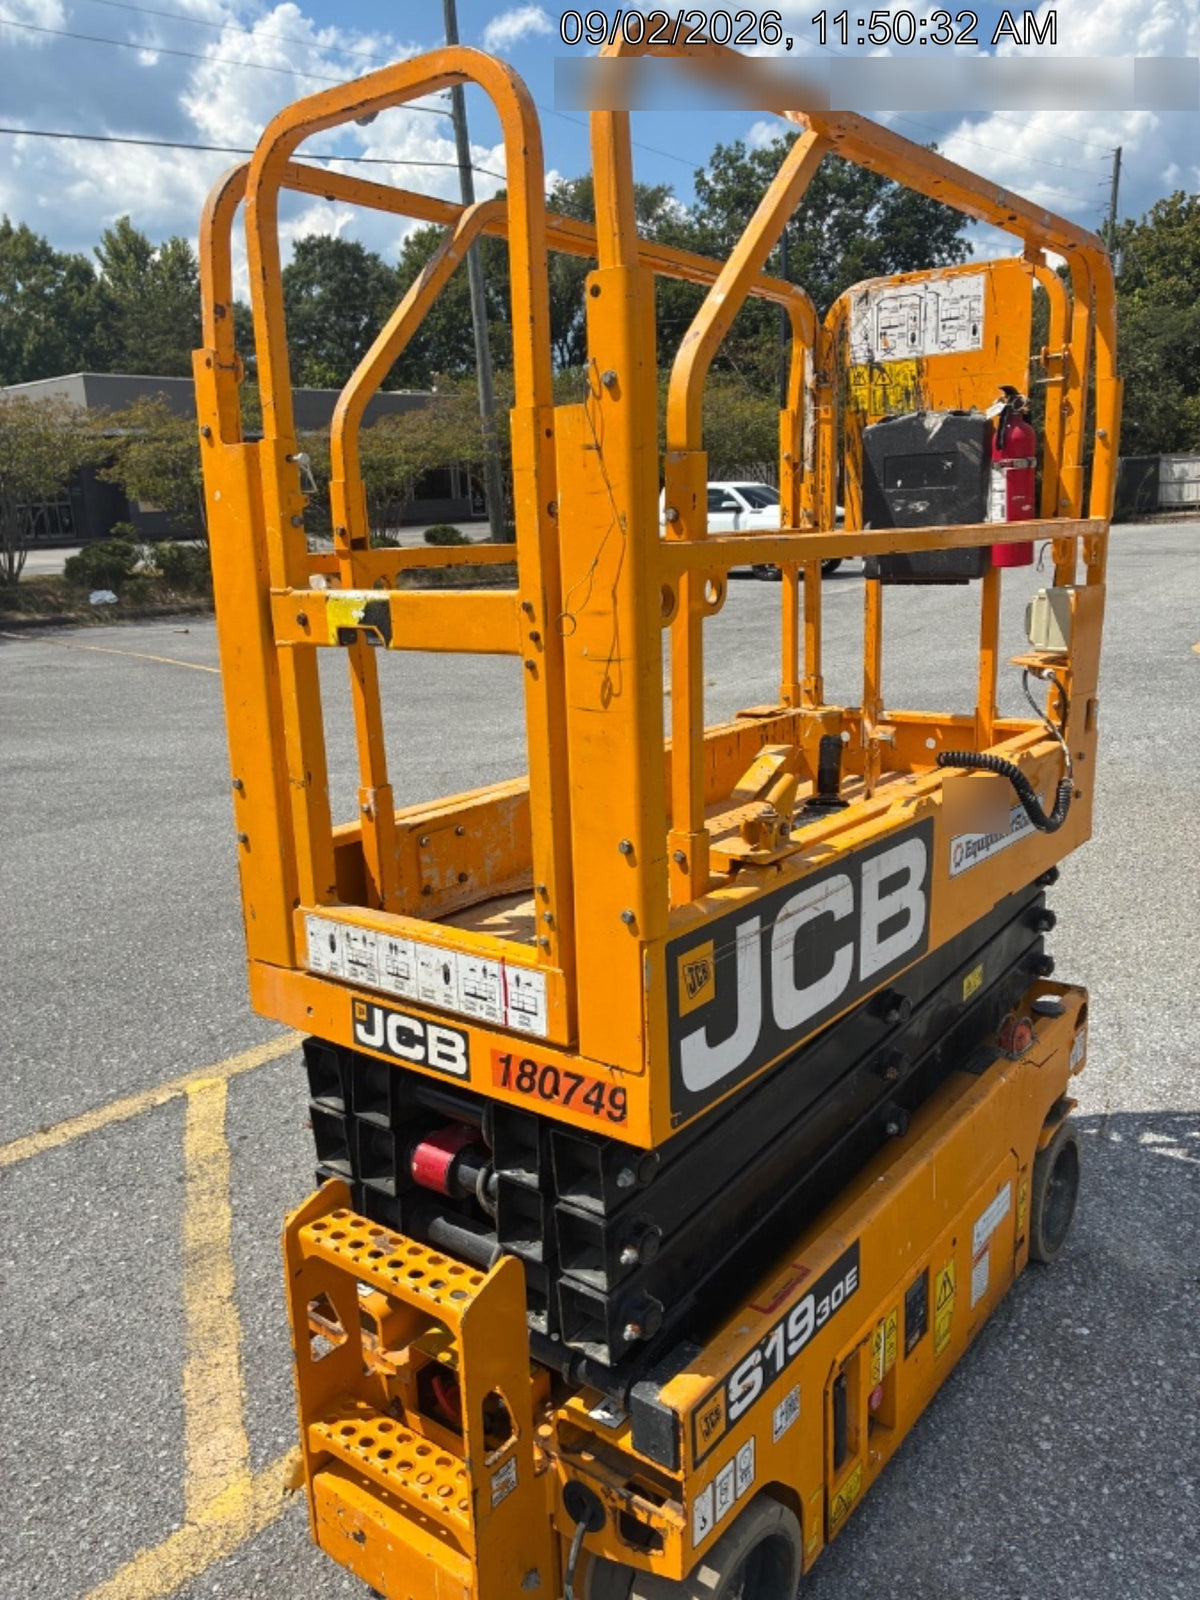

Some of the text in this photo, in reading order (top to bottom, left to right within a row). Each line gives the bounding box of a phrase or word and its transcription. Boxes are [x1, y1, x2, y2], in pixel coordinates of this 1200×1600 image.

[680, 838, 927, 1092] JCB
[684, 959, 710, 999] JCB
[356, 1008, 468, 1075] JCB
[498, 1053, 627, 1123] 180749
